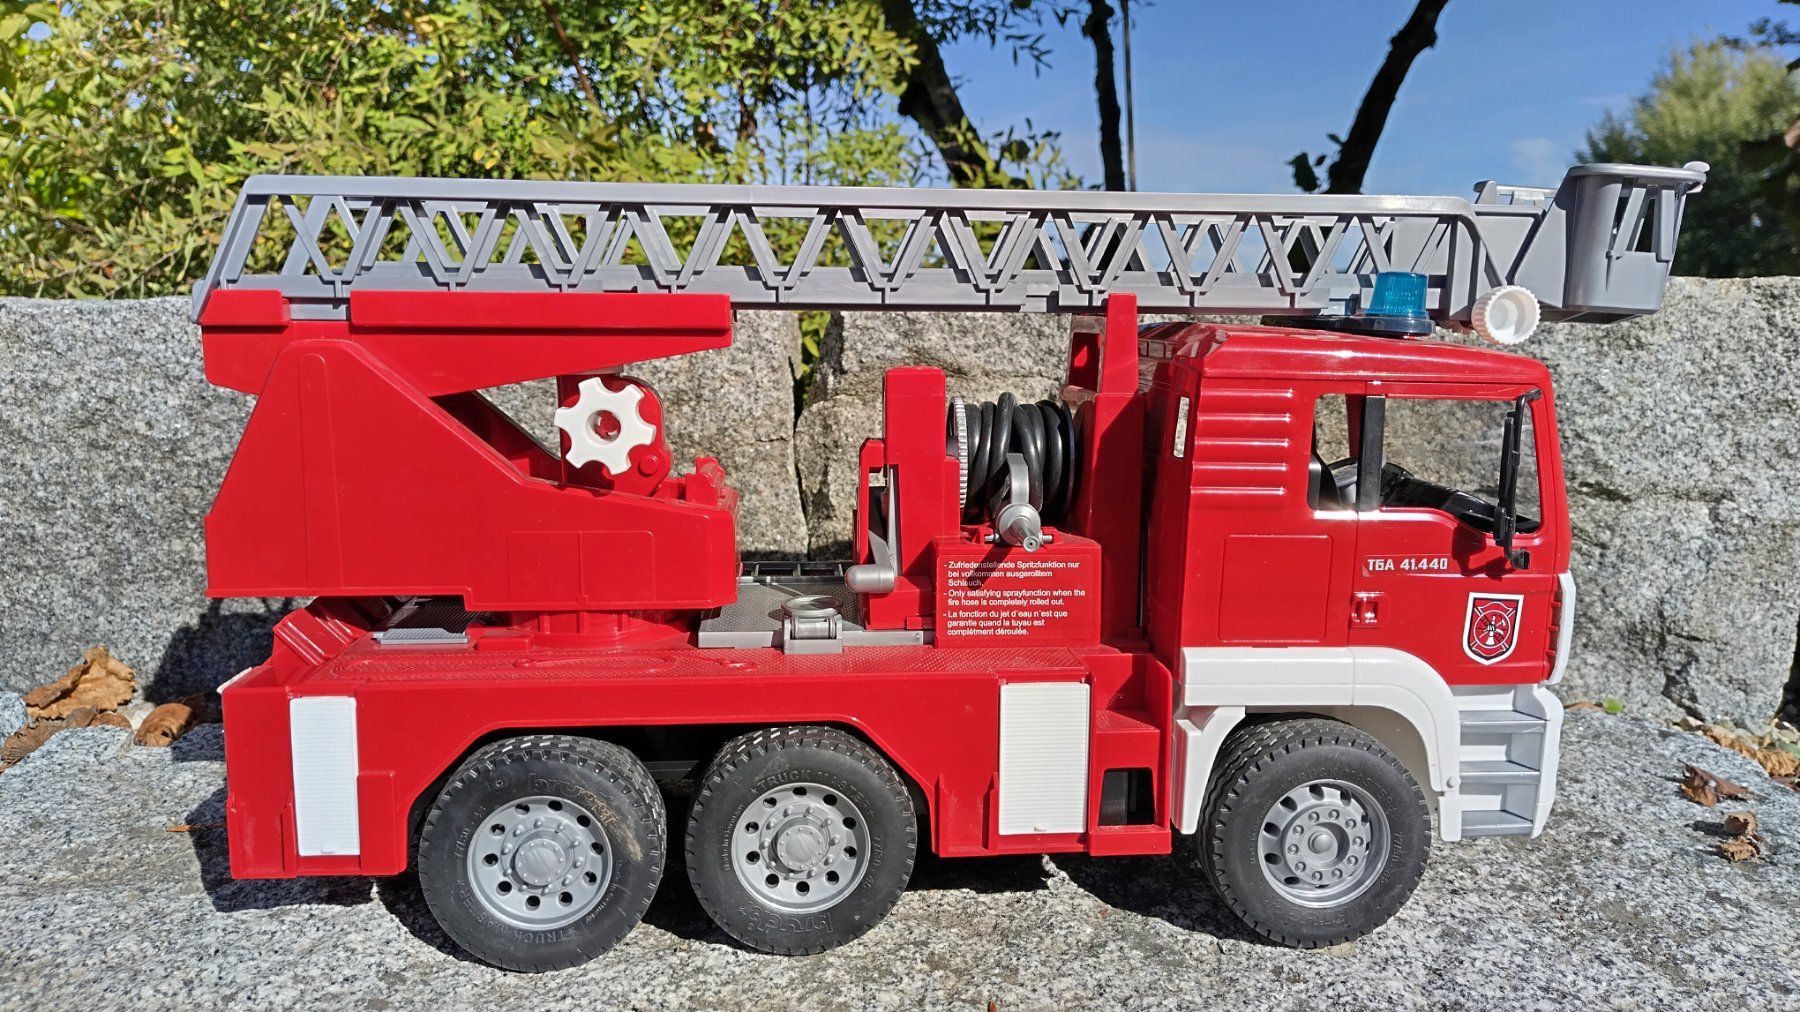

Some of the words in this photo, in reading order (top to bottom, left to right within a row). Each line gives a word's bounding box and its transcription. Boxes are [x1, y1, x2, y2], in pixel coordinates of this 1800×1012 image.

[1017, 561, 1066, 570] Spritzfunktion
[1368, 558, 1394, 571] TGA
[1400, 558, 1448, 570] 41.440
[1006, 570, 1052, 578] ausgerolltem
[948, 590, 965, 598] Only
